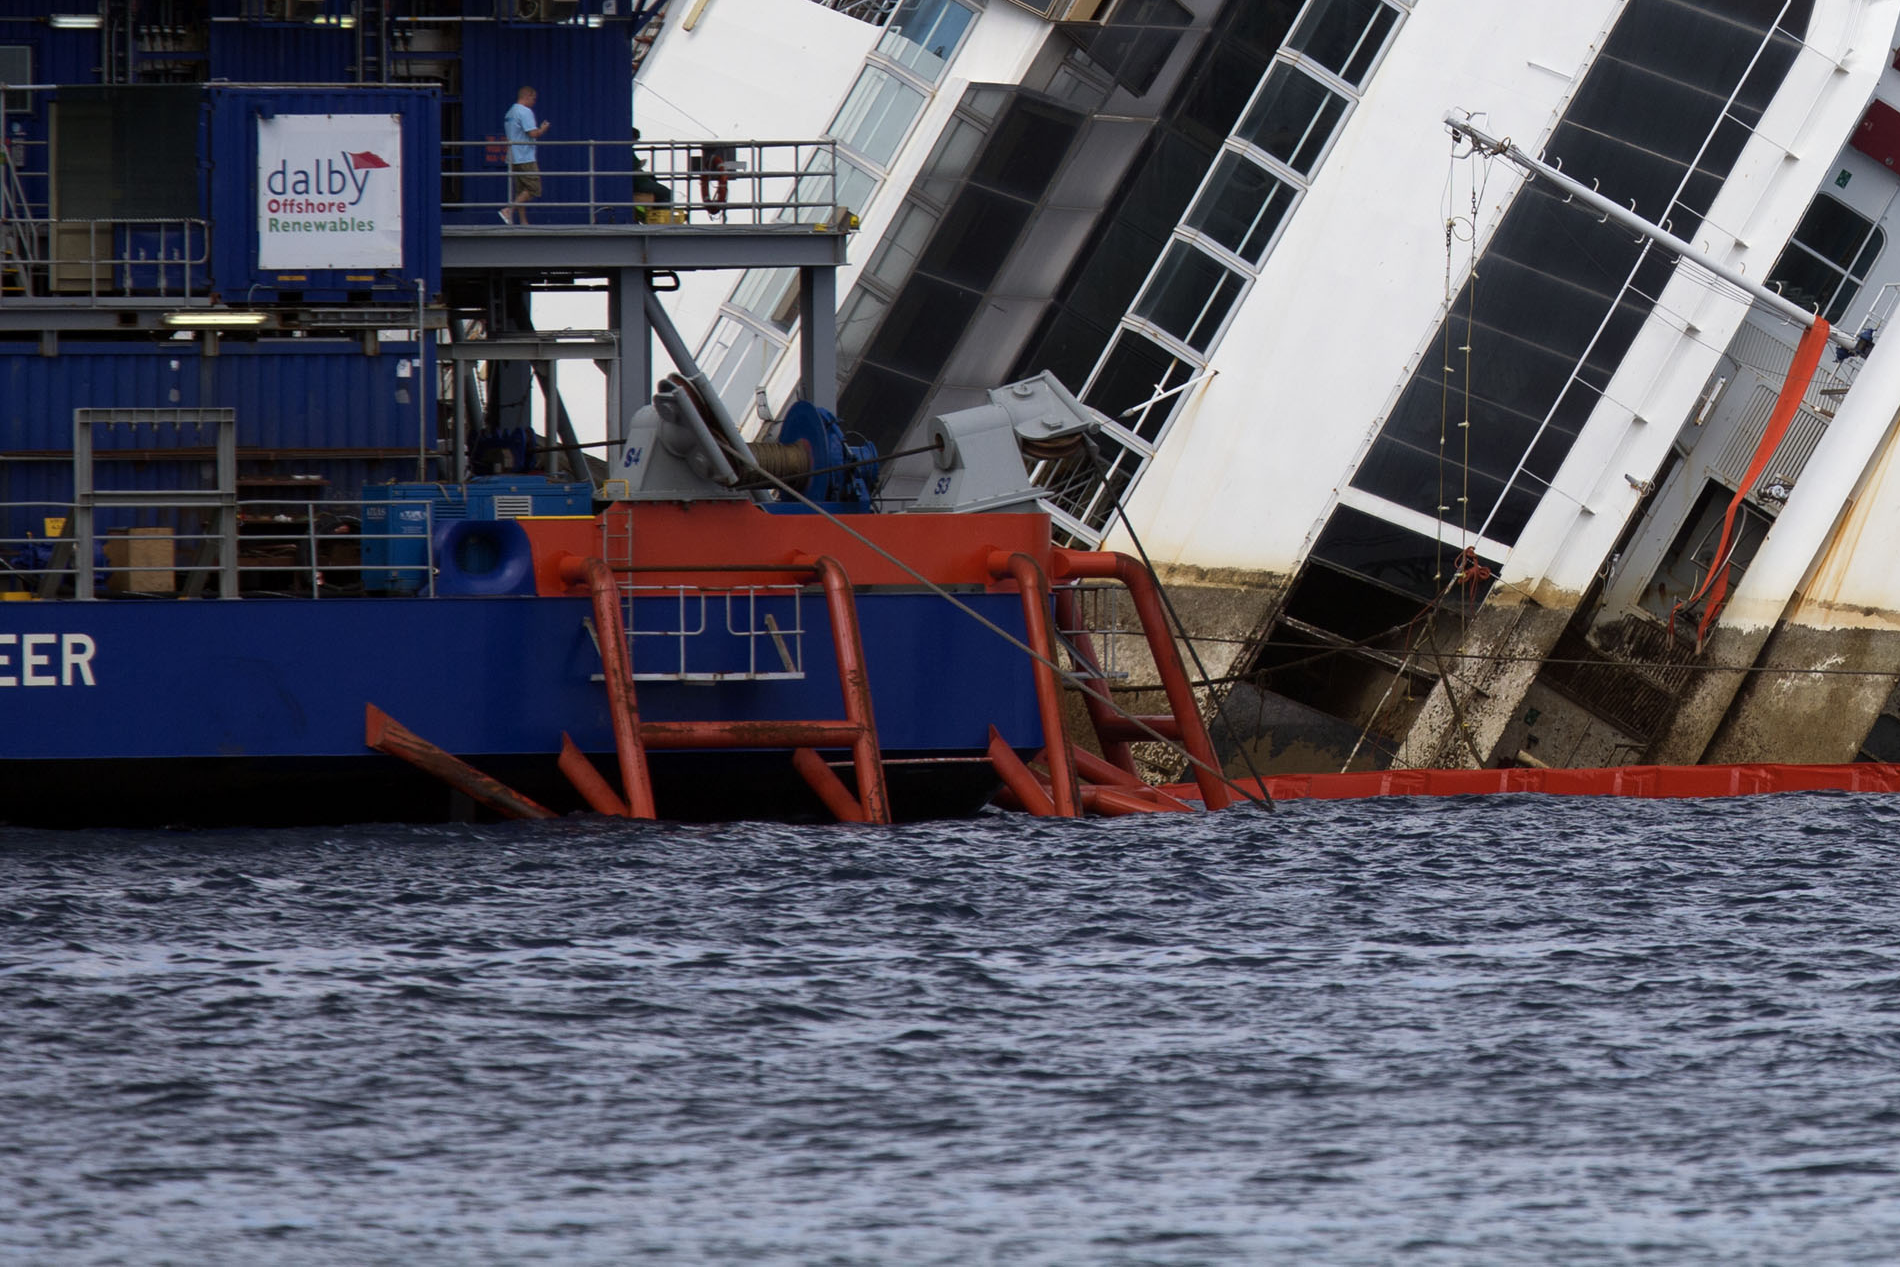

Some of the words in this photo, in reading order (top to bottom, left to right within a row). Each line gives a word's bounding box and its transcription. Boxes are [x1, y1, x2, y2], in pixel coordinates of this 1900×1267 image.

[267, 151, 370, 206] dalby
[267, 199, 348, 214] Offshore
[268, 218, 375, 232] Renewables
[624, 447, 643, 468] S4
[934, 477, 951, 494] S3
